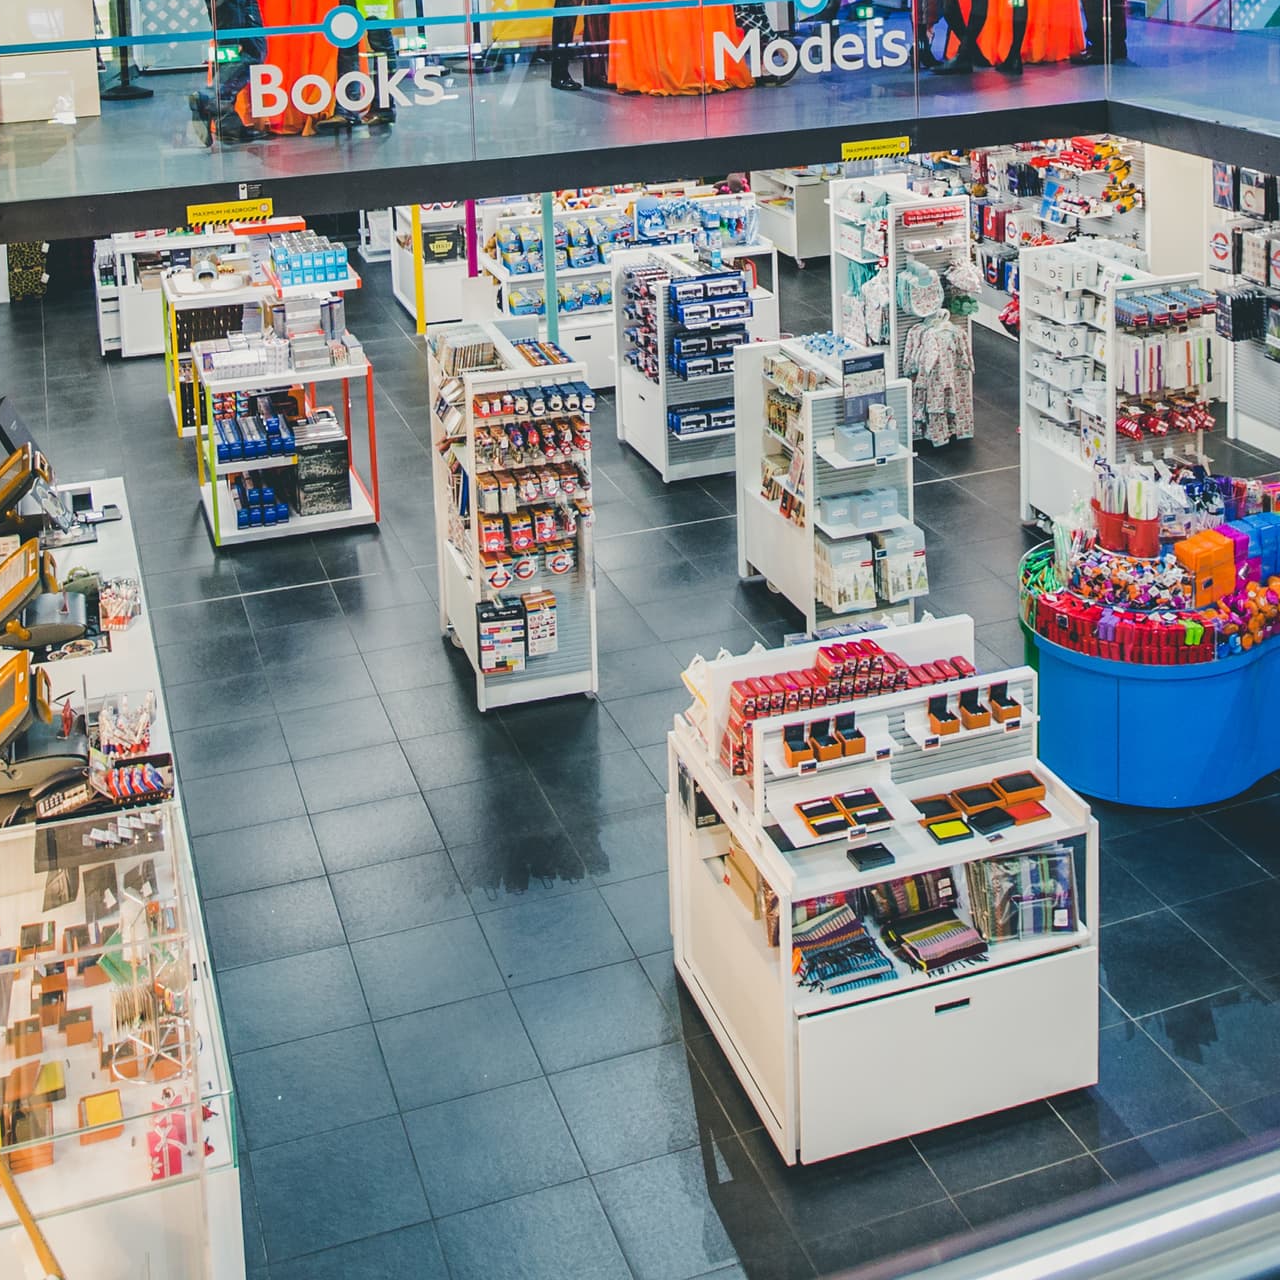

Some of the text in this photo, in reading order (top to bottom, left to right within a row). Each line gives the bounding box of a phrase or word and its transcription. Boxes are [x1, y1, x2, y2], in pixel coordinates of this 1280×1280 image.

[712, 19, 910, 82] Models
[249, 56, 446, 121] Books
[224, 206, 258, 215] HEADROOM
